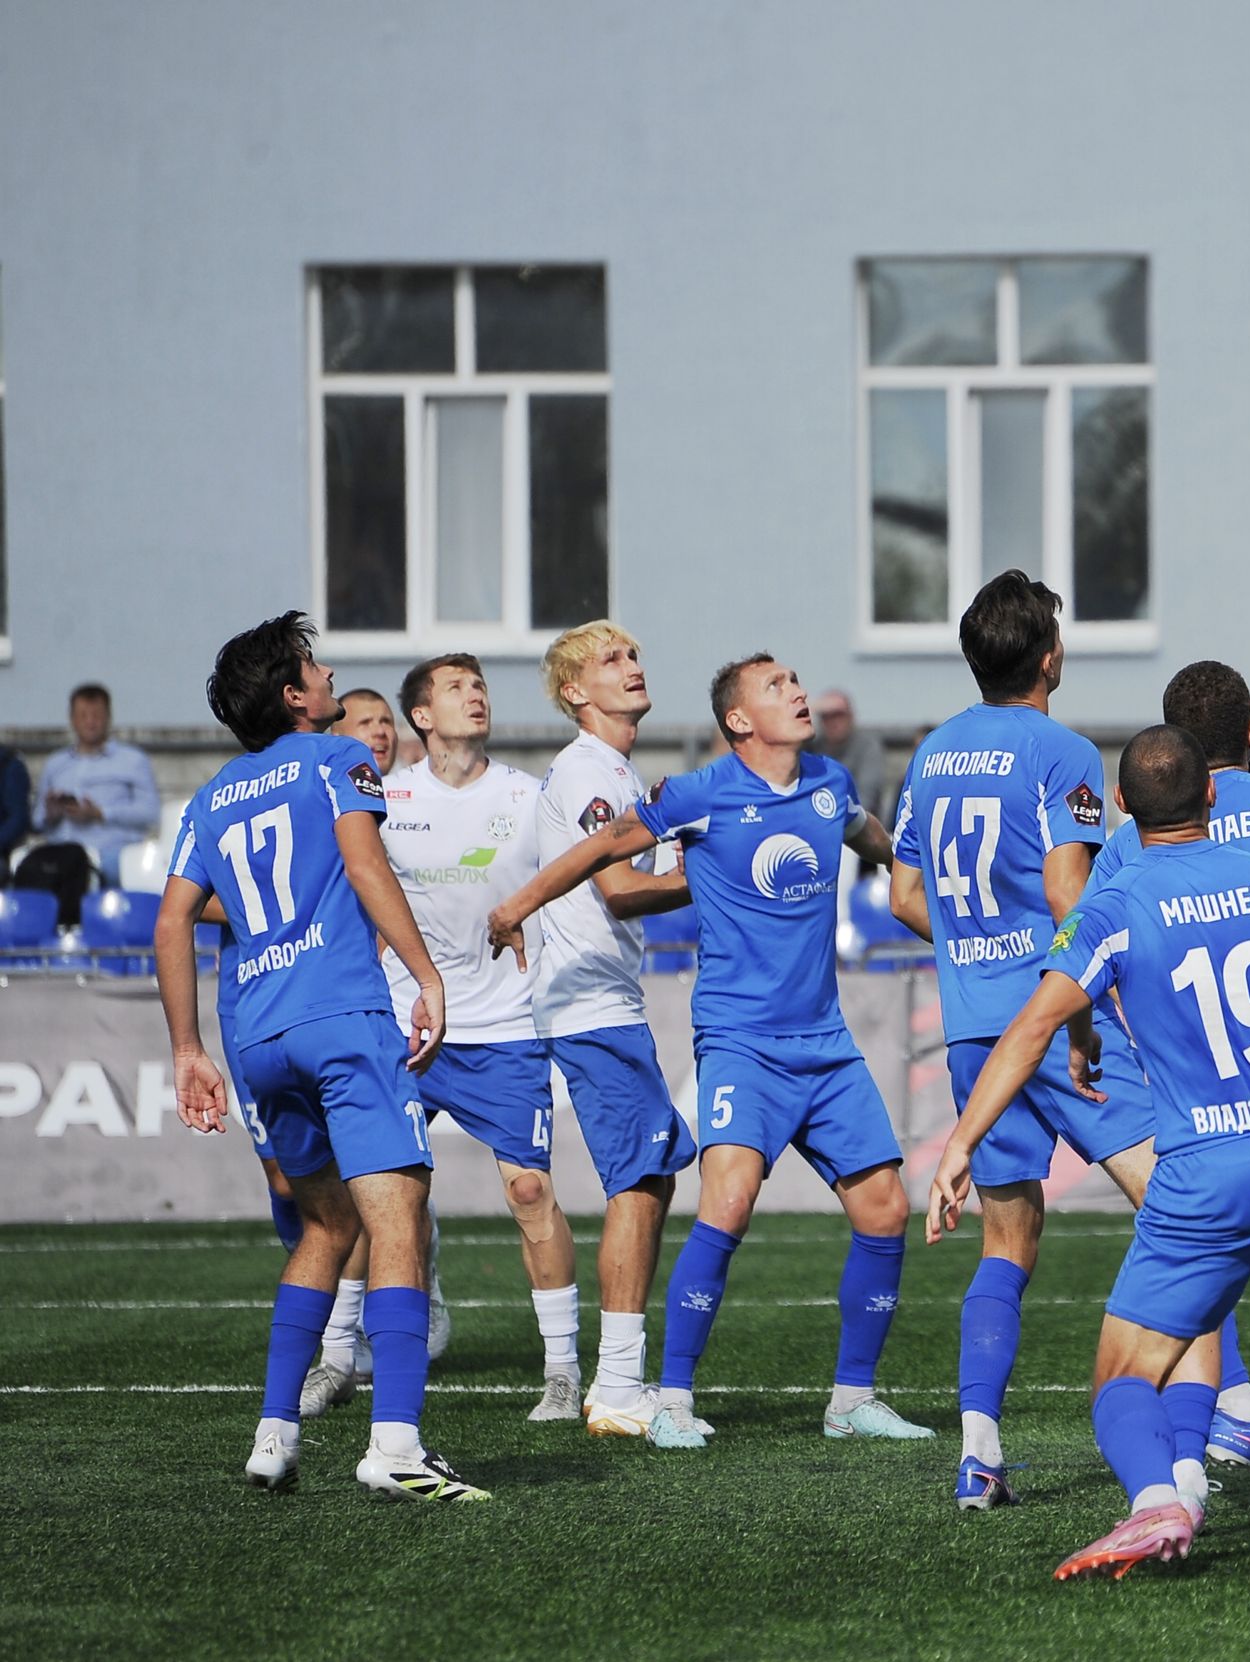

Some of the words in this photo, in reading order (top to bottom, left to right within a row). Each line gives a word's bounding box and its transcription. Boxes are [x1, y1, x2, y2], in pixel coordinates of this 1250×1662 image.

[210, 761, 301, 812] БОЛАТАЕВ
[921, 750, 1015, 779] НИКОЛАЕВ
[388, 822, 431, 831] LEGEA
[1073, 804, 1101, 818] LEON
[217, 802, 296, 936] 17
[930, 797, 1001, 918] 47
[709, 1085, 736, 1129] 5
